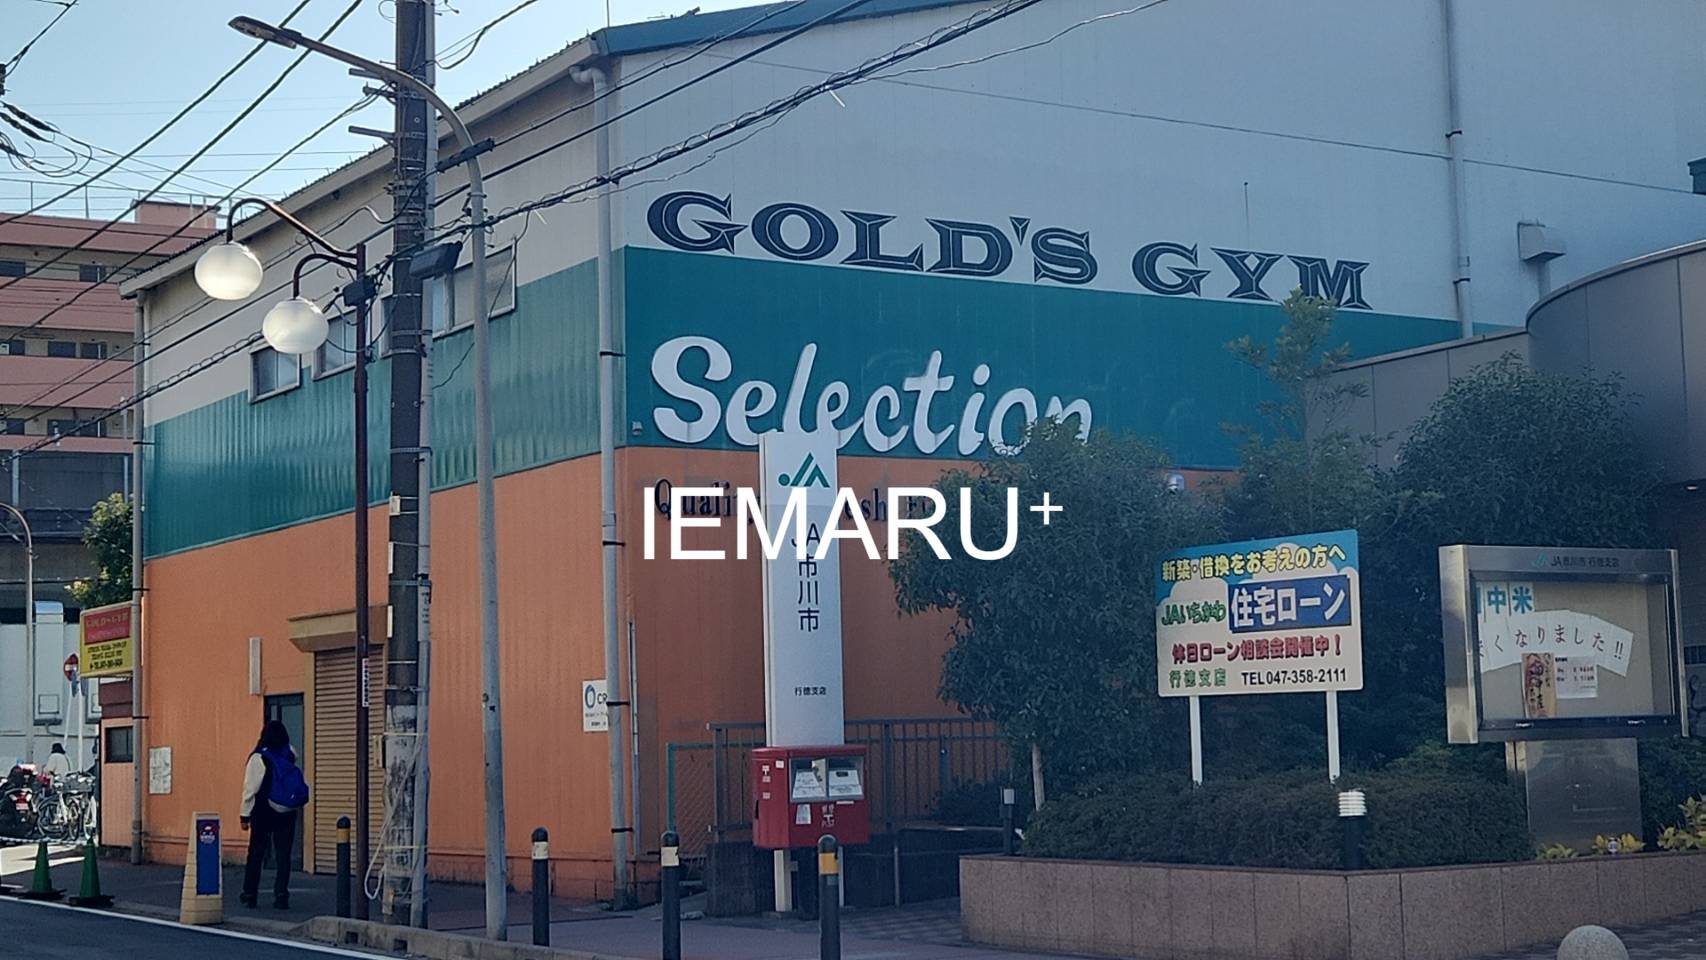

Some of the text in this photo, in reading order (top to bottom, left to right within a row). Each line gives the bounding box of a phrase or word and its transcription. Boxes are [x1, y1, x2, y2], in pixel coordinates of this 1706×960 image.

[646, 191, 1373, 310] GOLD'S GYM
[650, 335, 1093, 455] Selection
[654, 479, 760, 524] Quali
[1162, 545, 1346, 581] 新築・借換をお考えの方へ
[1231, 583, 1346, 628] 住宅ローン
